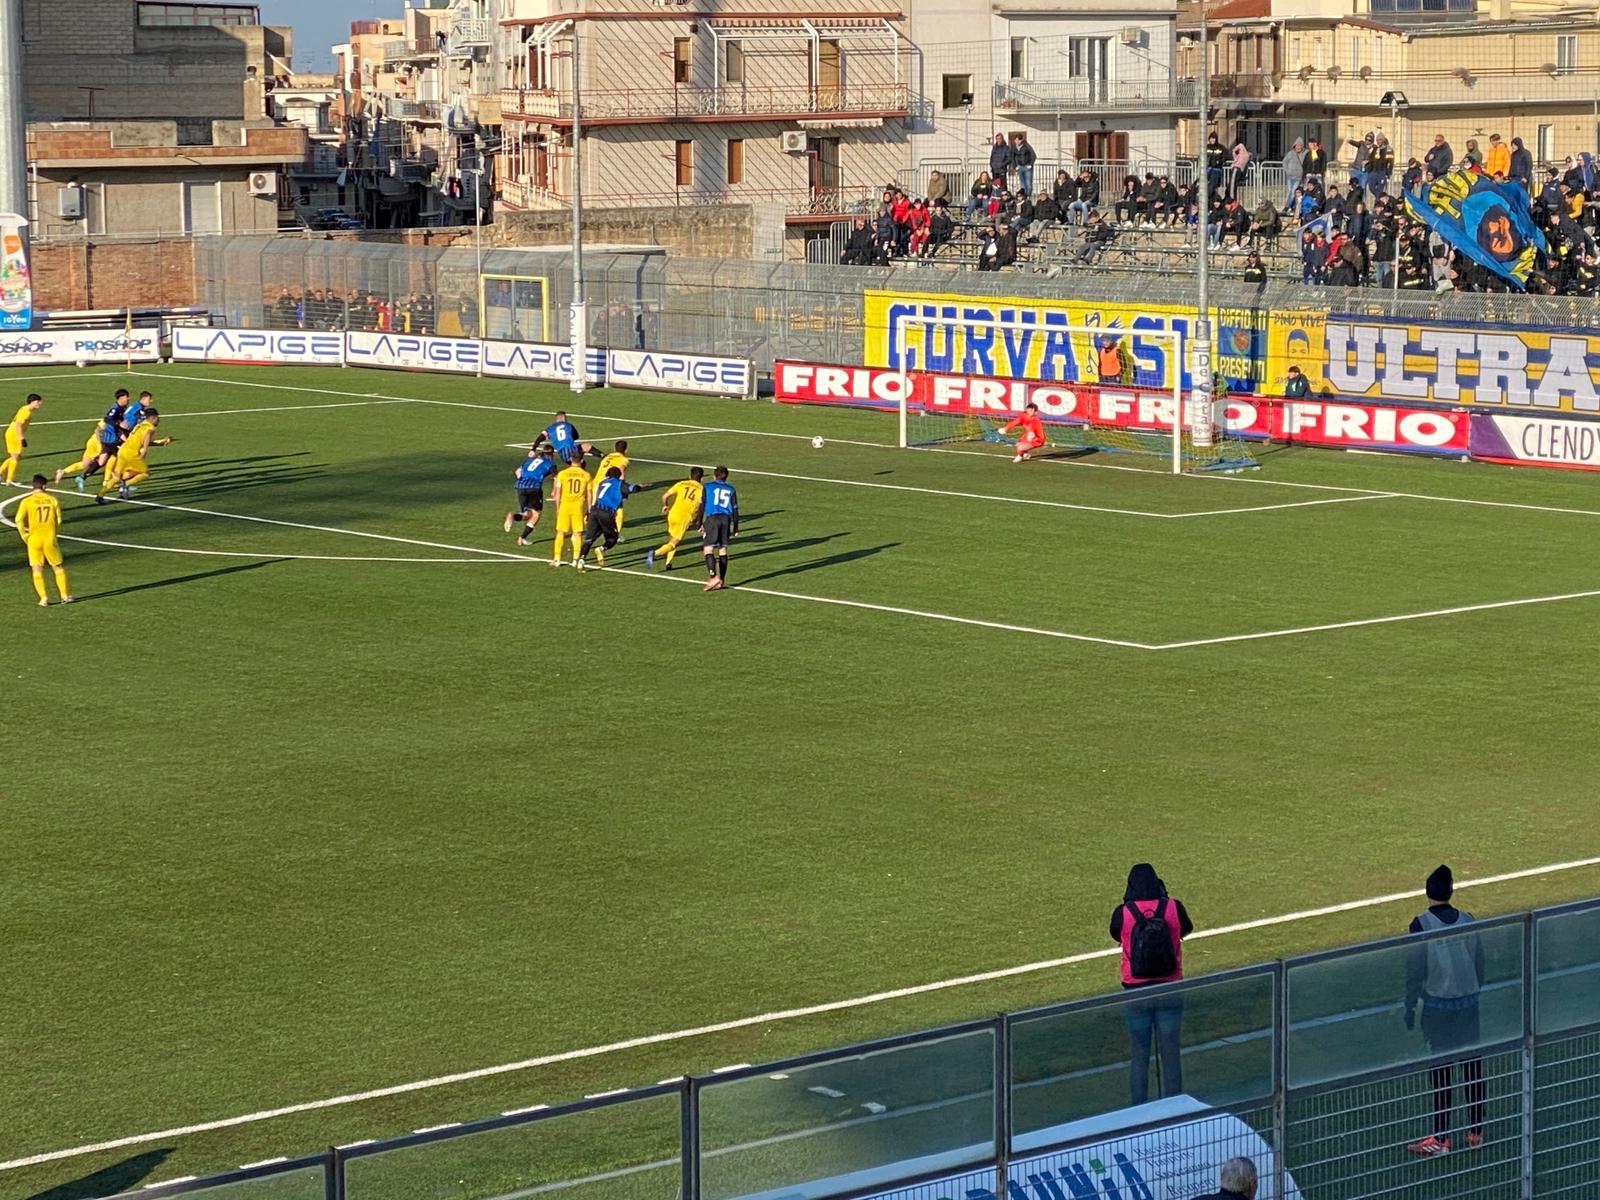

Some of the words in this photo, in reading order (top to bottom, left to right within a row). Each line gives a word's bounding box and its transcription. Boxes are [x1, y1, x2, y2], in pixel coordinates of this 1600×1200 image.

[1220, 308, 1267, 331] DIFFIDATI
[74, 339, 151, 352] PROSHOP
[176, 331, 341, 356] LAPIGE
[348, 334, 480, 364] LAPIGE
[888, 303, 1080, 384] CURVA
[377, 357, 479, 371] LIGHTING
[612, 353, 746, 385] LAPIGE
[1219, 357, 1265, 382] PRESENTI
[641, 378, 745, 393] LIGHTING
[782, 365, 914, 402] FRIO
[933, 377, 1077, 417] FRIO
[556, 424, 566, 441] 6
[1282, 402, 1456, 446] FRIO
[1522, 423, 1600, 460] CLEND
[527, 458, 543, 472] 8
[568, 478, 581, 494] 10
[597, 482, 611, 499] 7
[683, 486, 696, 501] 14
[713, 487, 731, 508] 15
[37, 506, 50, 523] 17
